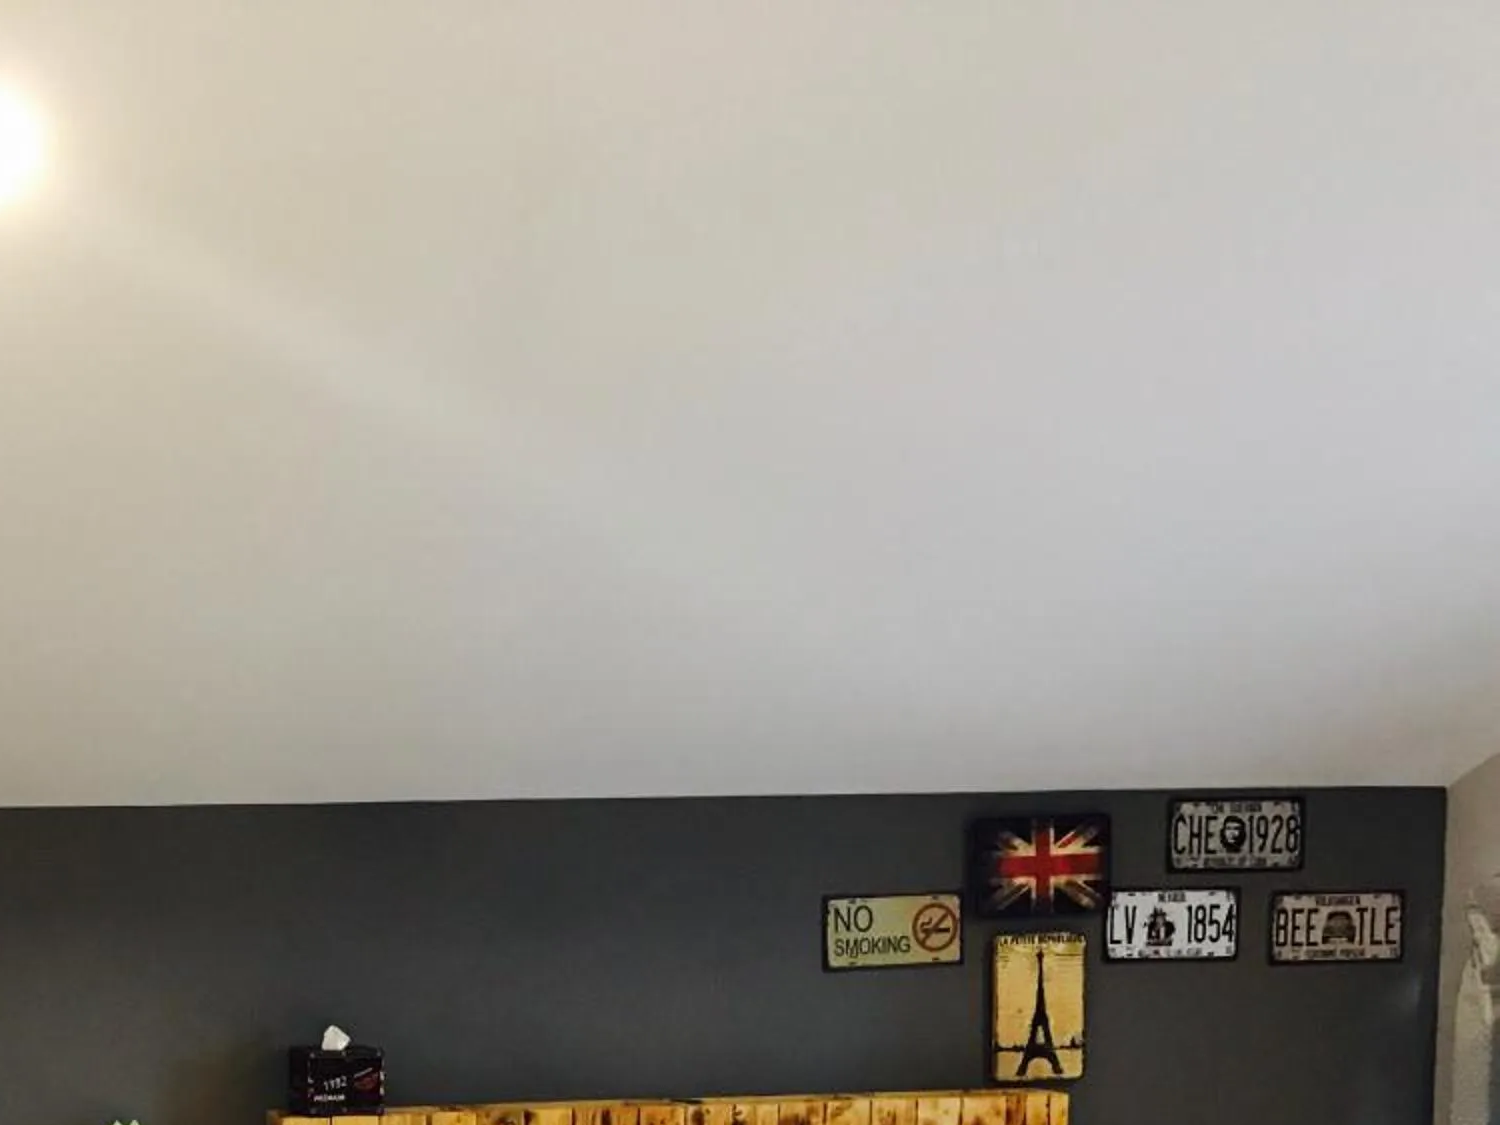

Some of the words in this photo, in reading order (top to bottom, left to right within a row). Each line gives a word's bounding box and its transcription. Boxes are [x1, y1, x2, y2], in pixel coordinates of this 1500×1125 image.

[1173, 814, 1218, 854] CHE
[1248, 814, 1299, 853] 1928
[833, 905, 874, 933] NO
[1108, 904, 1137, 945] LV
[1186, 903, 1235, 944] 1854
[1275, 907, 1319, 947] BEE
[1356, 906, 1399, 946] TLE
[833, 935, 911, 959] SMOKING
